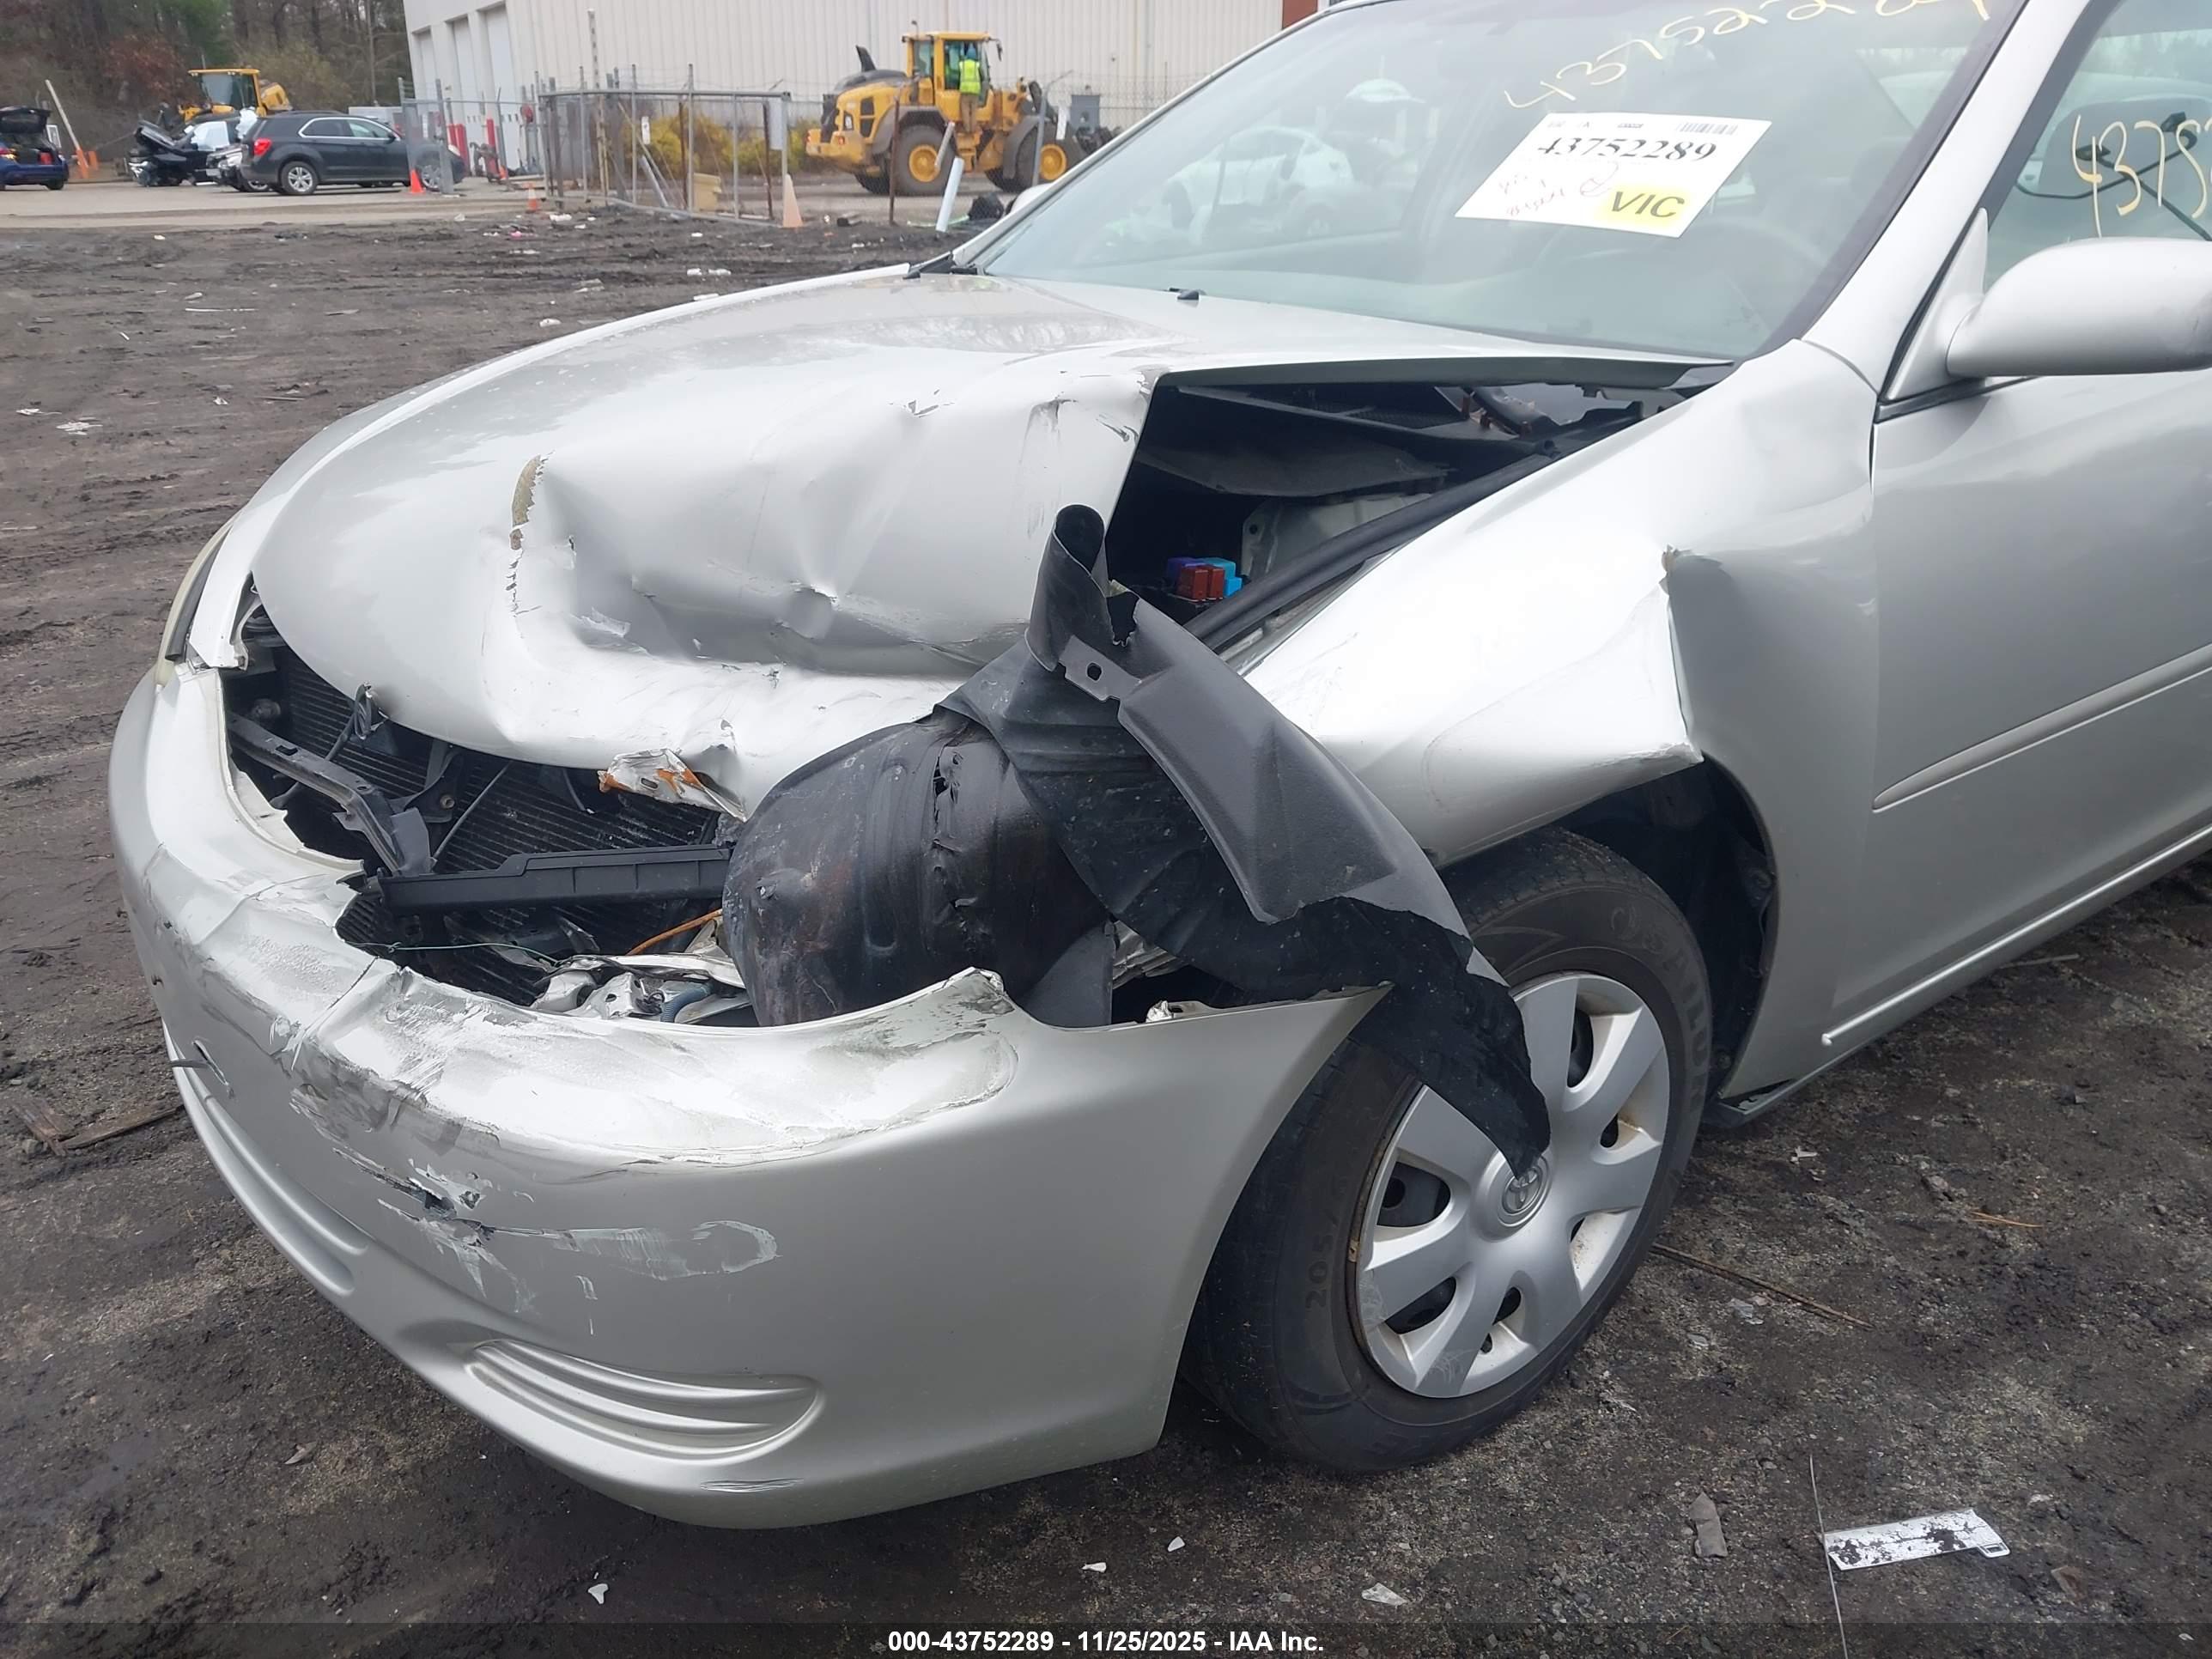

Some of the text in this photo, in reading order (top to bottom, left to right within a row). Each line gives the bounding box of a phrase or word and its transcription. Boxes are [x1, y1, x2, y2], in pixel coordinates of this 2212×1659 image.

[1537, 137, 1717, 161] 43752289
[2071, 114, 2212, 239] 4375
[1610, 191, 1686, 218] VIC
